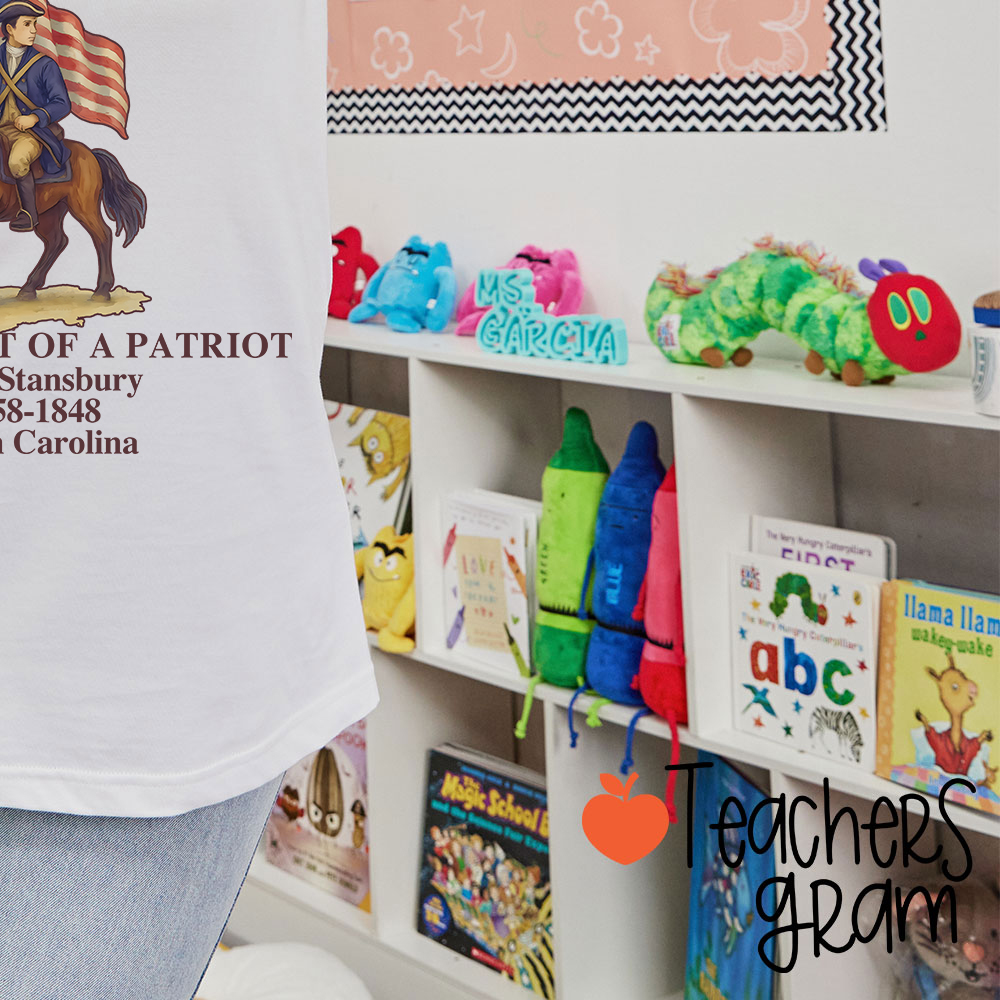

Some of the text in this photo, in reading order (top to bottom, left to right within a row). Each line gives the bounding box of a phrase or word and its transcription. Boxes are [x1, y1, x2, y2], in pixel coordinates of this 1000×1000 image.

[476, 270, 528, 306] MS
[26, 330, 81, 360] OF
[90, 330, 116, 360] A
[125, 330, 294, 360] PATRIOT
[477, 311, 622, 364] GARCIA
[12, 429, 140, 457] Carolina
[798, 535, 824, 551] Hungry
[461, 553, 495, 577] LOVE
[904, 593, 954, 628] llama
[750, 636, 856, 707] abc
[441, 771, 488, 811] Magic
[487, 788, 541, 833] School
